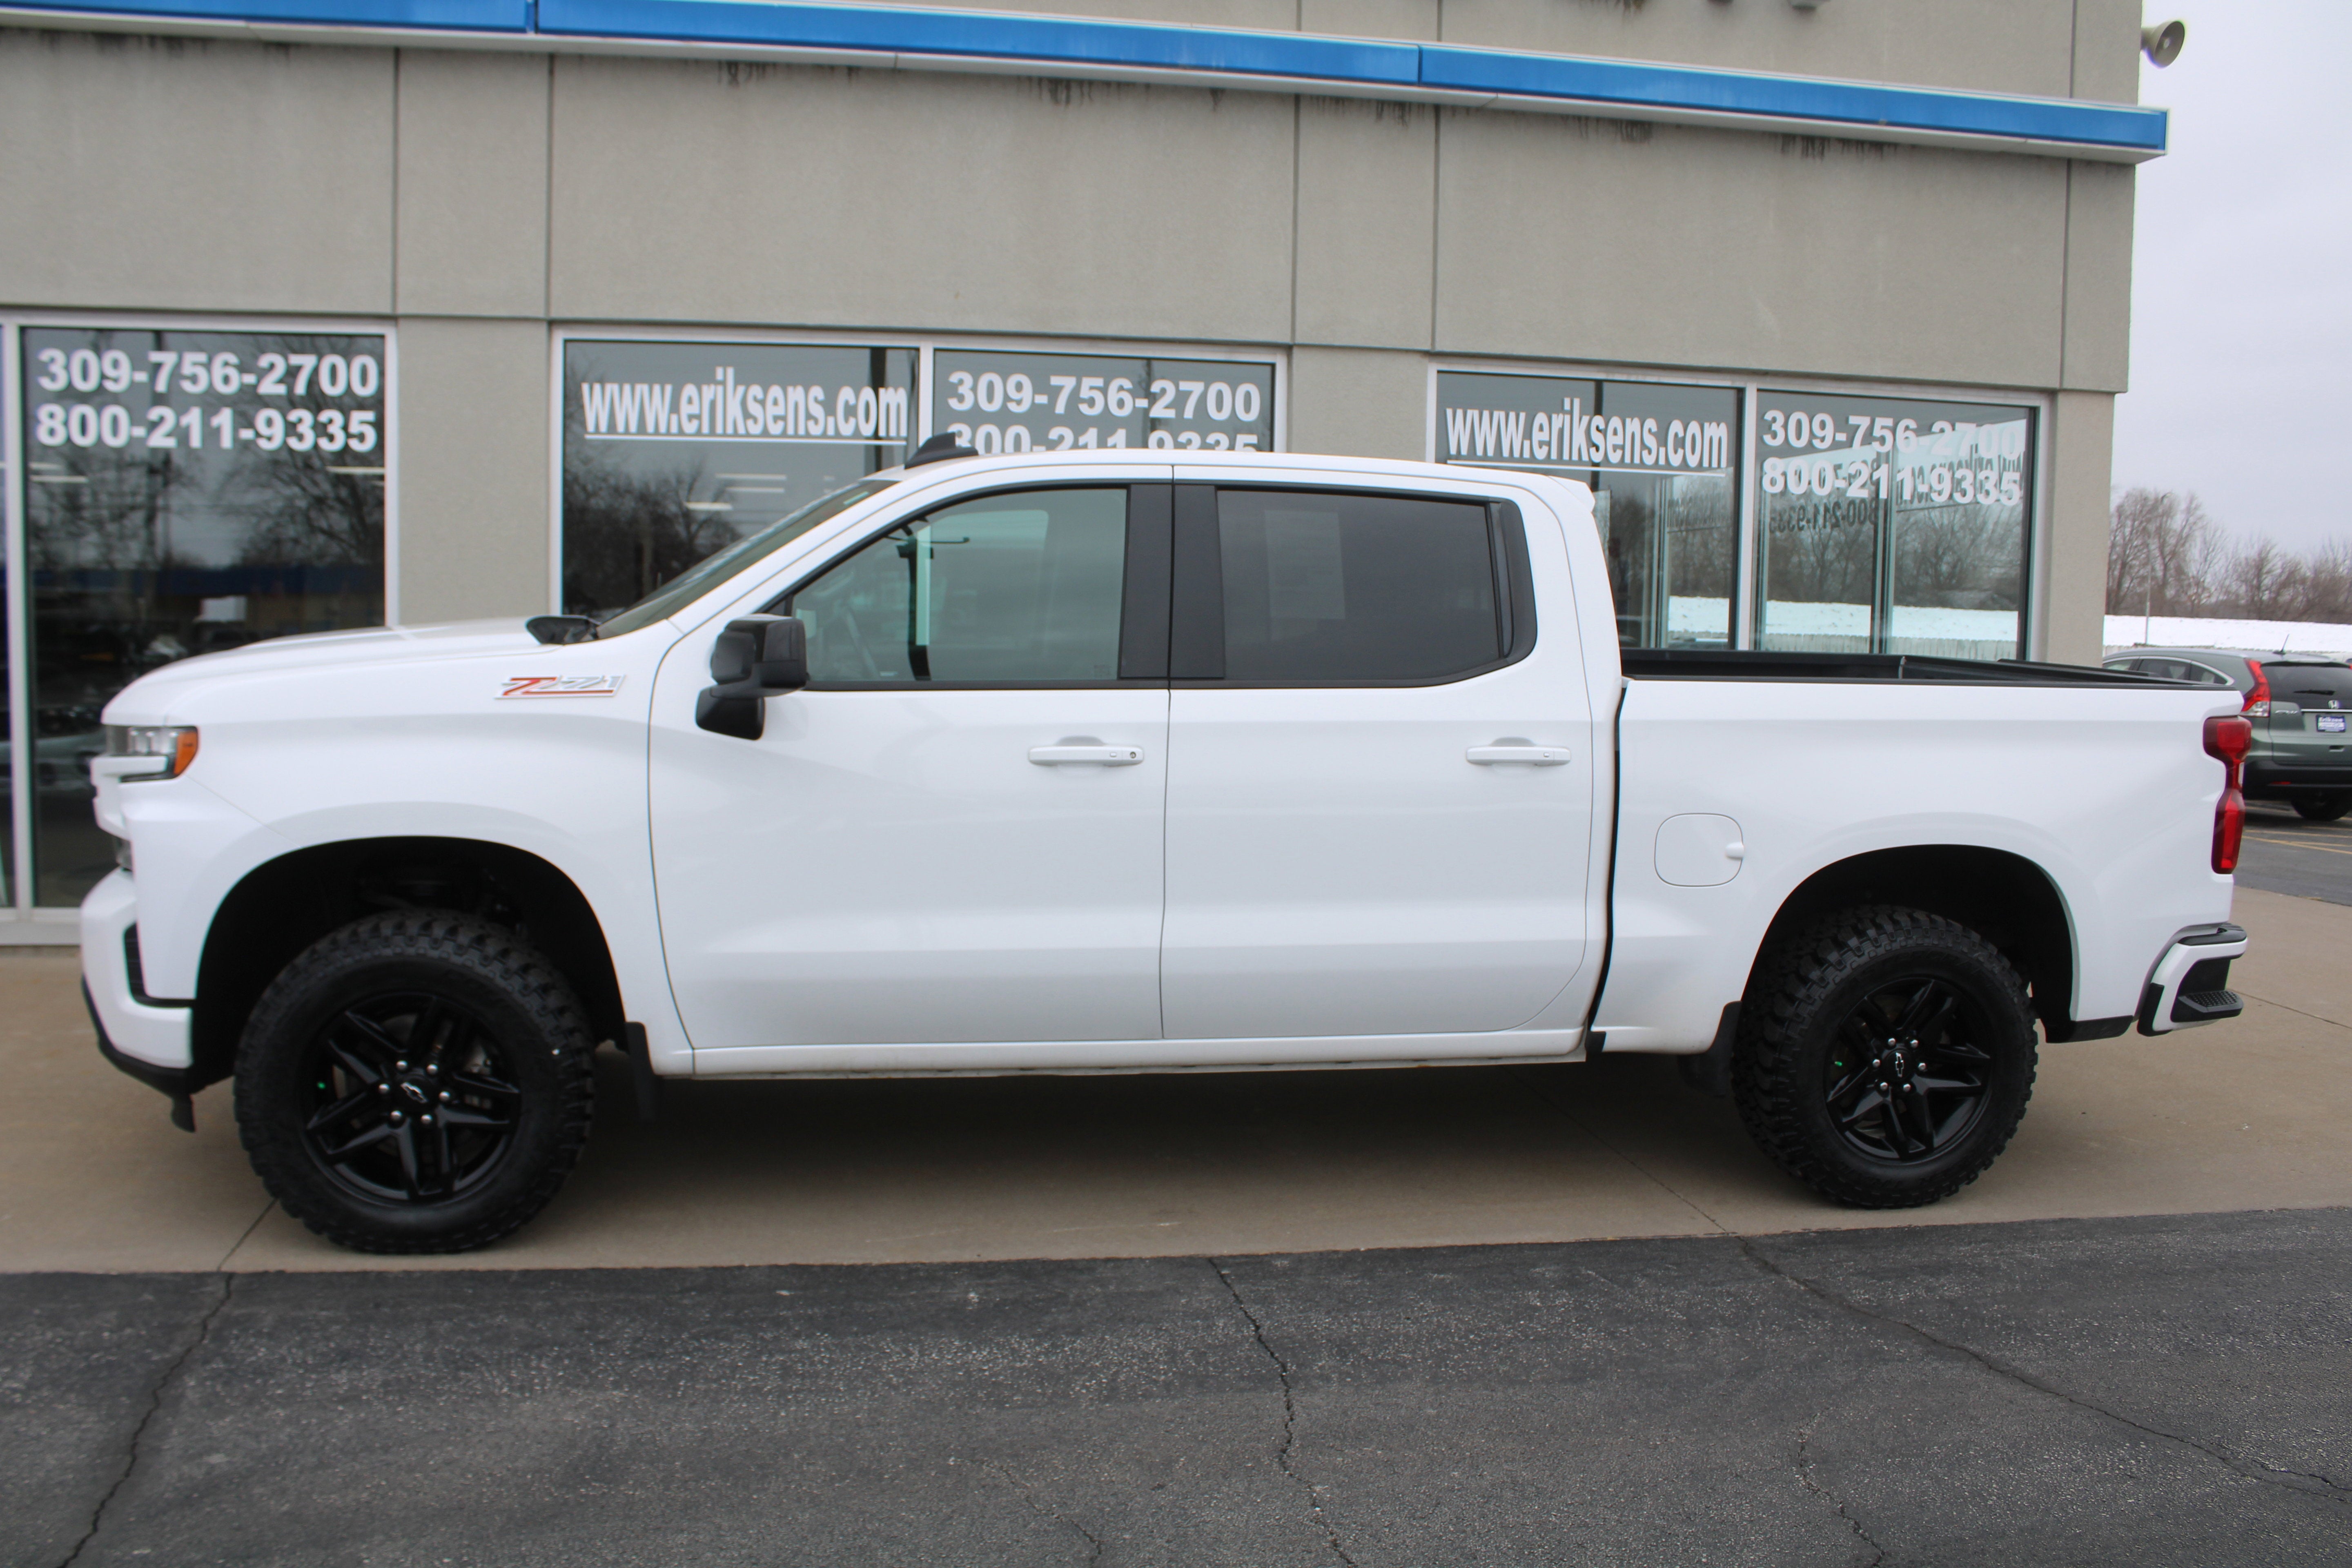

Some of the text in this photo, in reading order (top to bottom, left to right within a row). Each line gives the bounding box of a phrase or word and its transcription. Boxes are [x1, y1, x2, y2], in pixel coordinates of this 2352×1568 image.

[38, 348, 379, 396] 309-756-2700
[947, 371, 1261, 422] 309-756-2700
[581, 366, 907, 437] www.eriksens.com
[36, 404, 376, 452] 800-211-9335
[1446, 397, 1728, 468] www.eriksens.com
[1762, 410, 2025, 460] 309-756-2700
[1762, 457, 2021, 506] 800-211-9335
